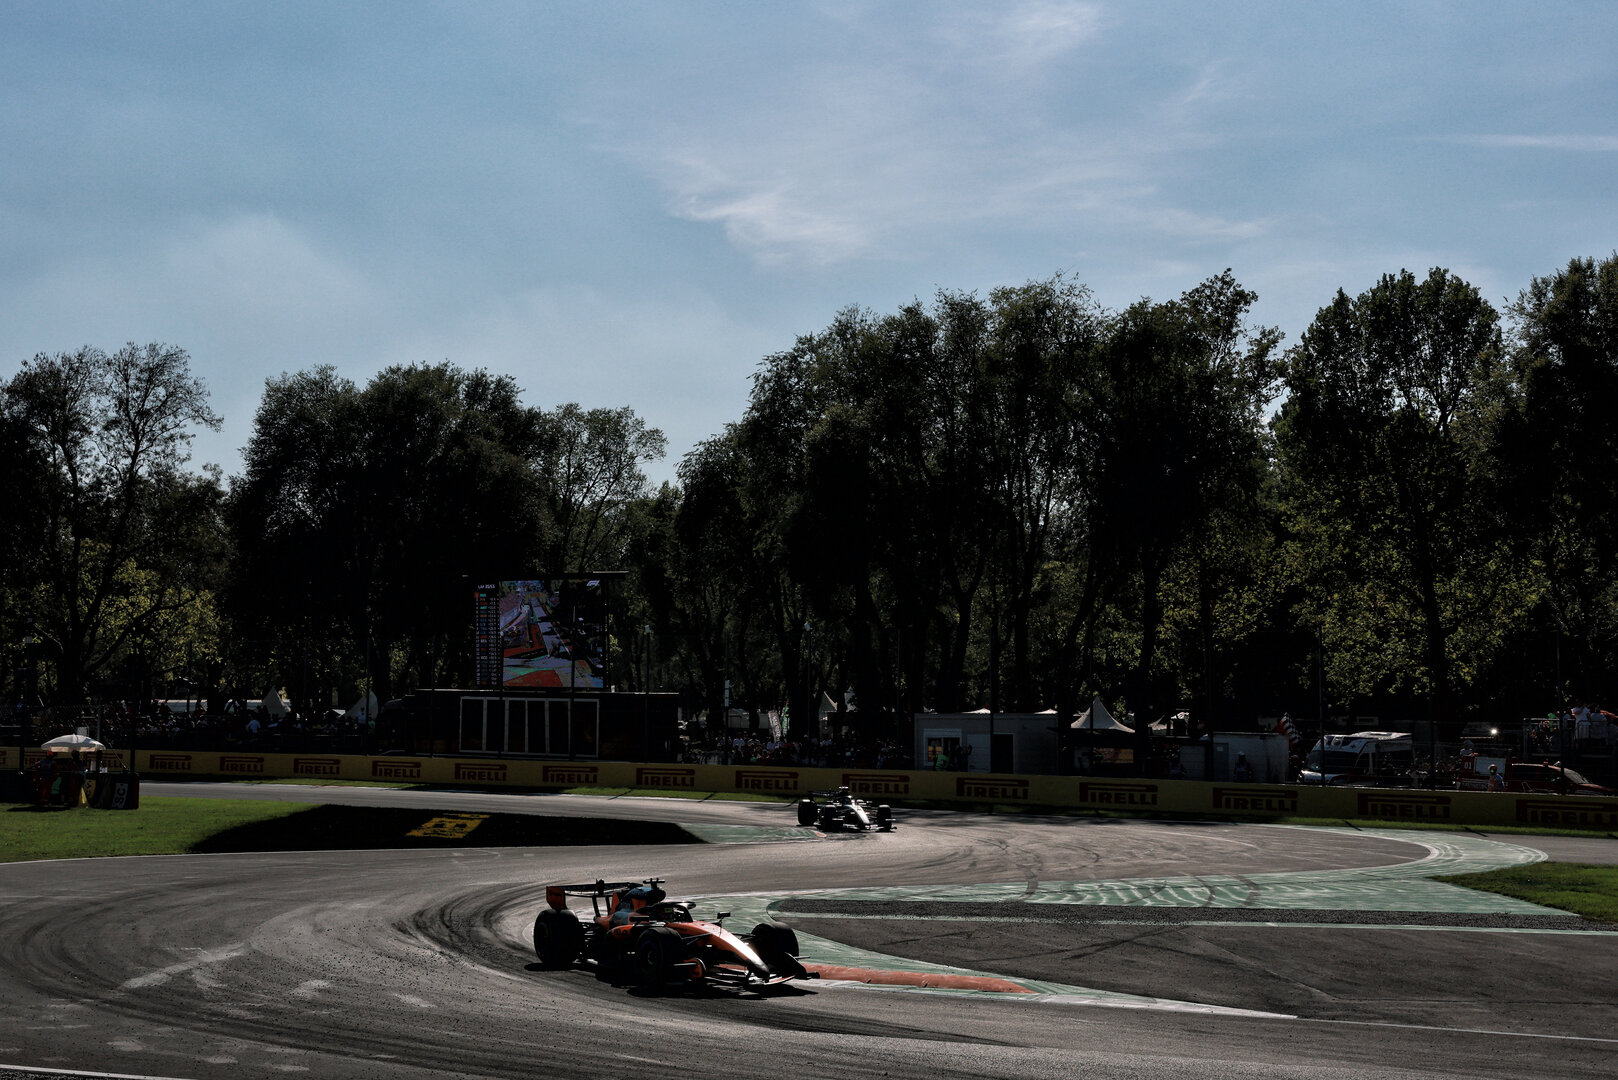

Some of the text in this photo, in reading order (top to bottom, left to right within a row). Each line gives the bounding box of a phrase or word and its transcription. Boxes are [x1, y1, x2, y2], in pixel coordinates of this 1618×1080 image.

[150, 754, 192, 770] PIRELLI
[220, 756, 264, 773] PIRELLI
[294, 758, 341, 776] PIRELLI
[372, 760, 421, 778] PIRELLI
[455, 763, 507, 781] PIRELLI
[542, 766, 598, 784] PIRELLI
[636, 768, 695, 787] PIRELLI
[735, 770, 799, 790] PIRELLI
[842, 774, 910, 794] PIRELLI
[956, 777, 1029, 800] PIRELLI
[1079, 782, 1158, 805] PIRELLI
[1213, 787, 1298, 812] PIRELLI
[1357, 793, 1451, 819] PIRELLI
[1516, 799, 1618, 826] PIRELLI
